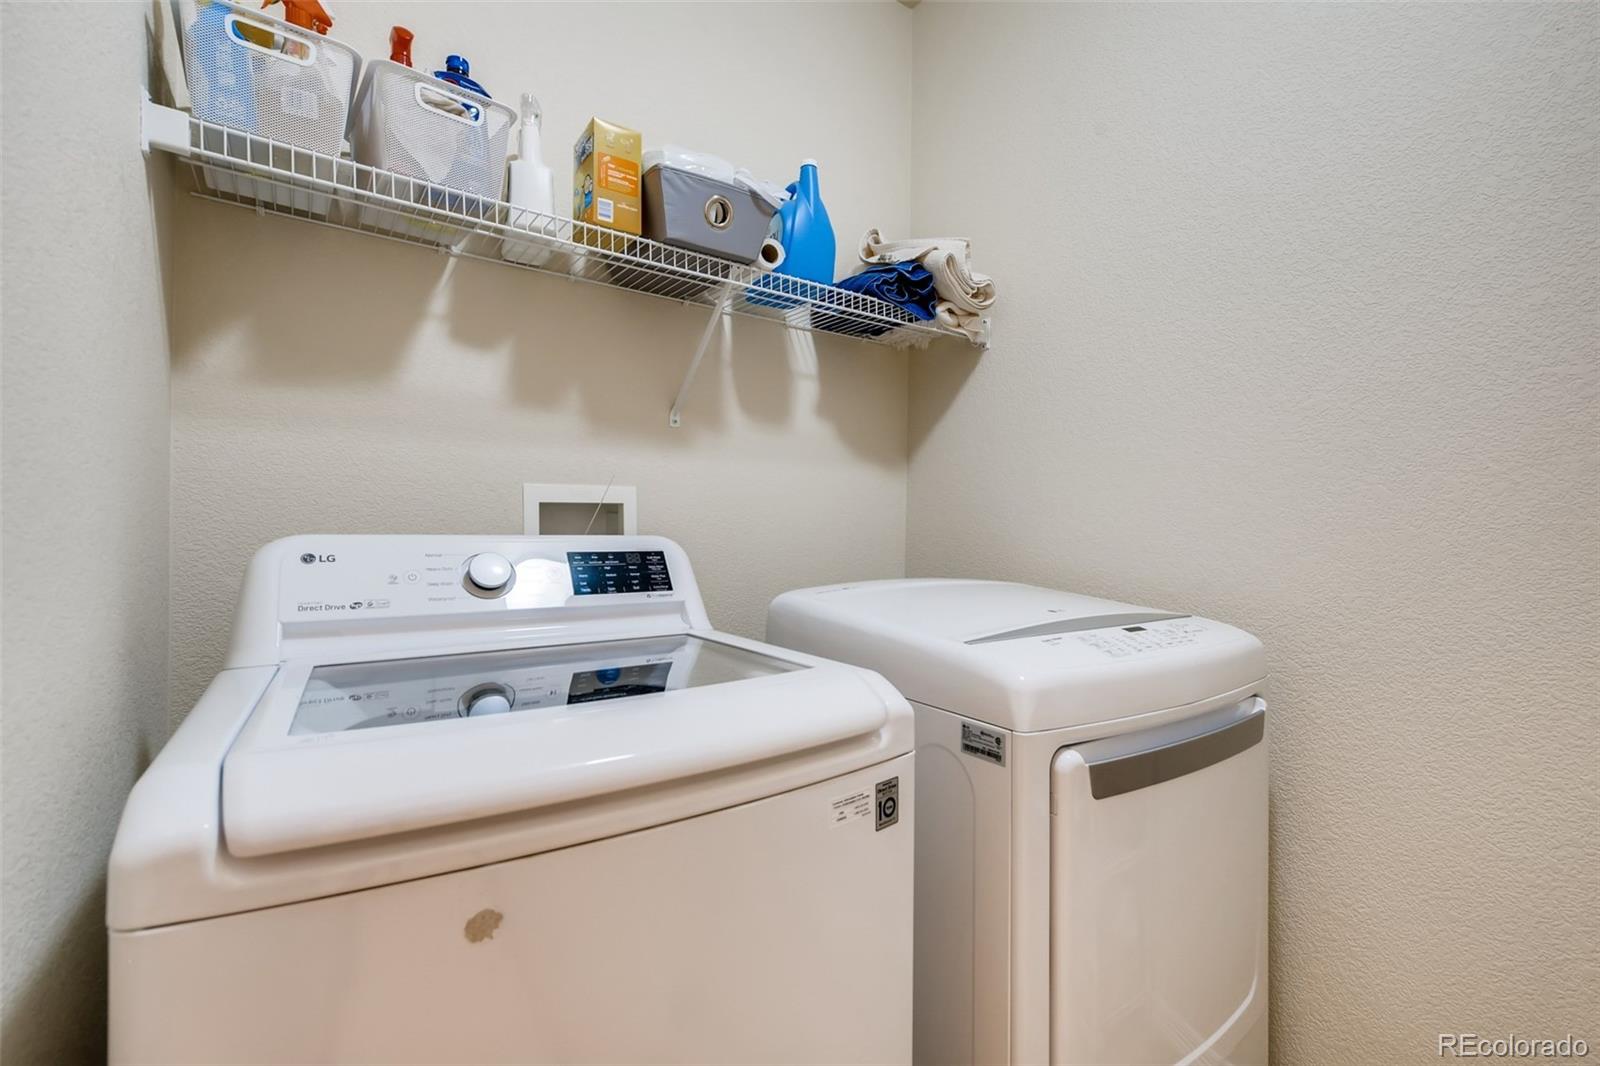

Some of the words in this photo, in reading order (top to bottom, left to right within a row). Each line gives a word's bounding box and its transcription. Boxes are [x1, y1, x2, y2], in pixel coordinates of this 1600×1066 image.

[319, 554, 336, 563] LG
[297, 604, 323, 612] Direct
[325, 603, 346, 611] Drive
